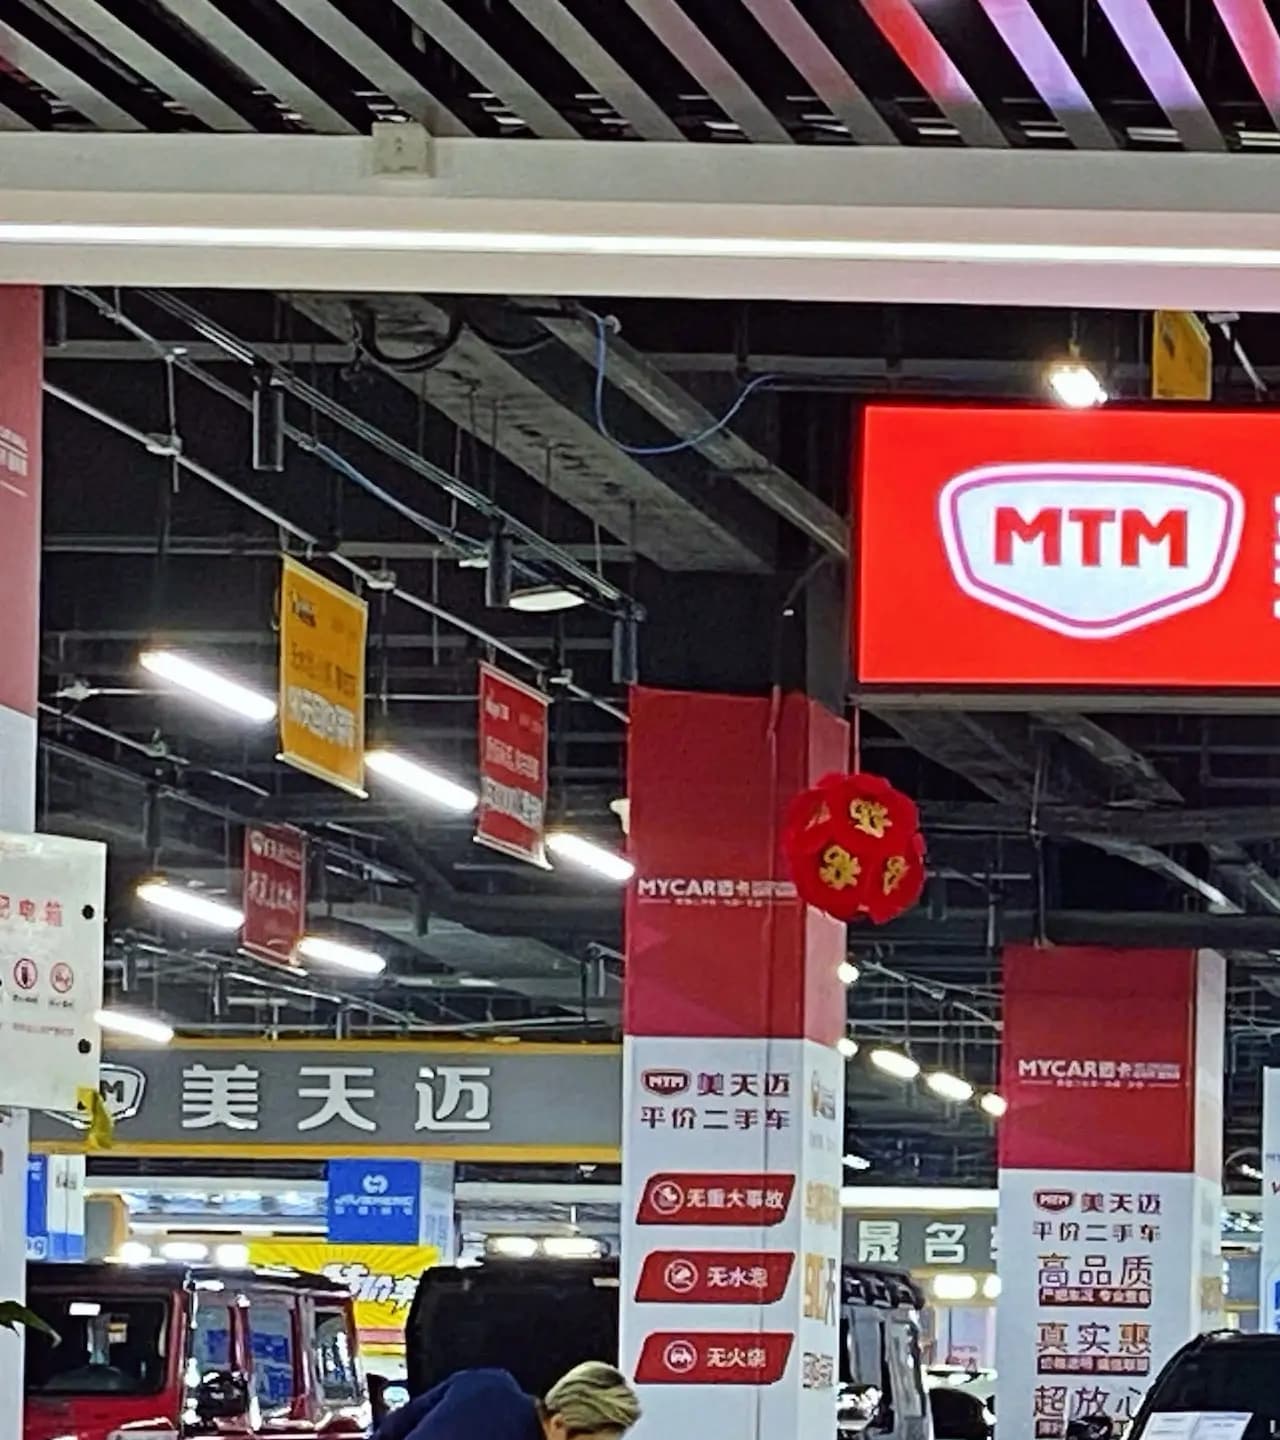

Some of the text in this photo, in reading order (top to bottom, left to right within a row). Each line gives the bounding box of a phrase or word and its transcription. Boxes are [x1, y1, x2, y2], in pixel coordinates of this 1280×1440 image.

[994, 506, 1188, 568] MTM
[182, 1063, 491, 1132] 美天迈
[697, 1072, 790, 1097] 美天迈
[640, 1106, 790, 1130] 平价二手车
[686, 1188, 785, 1210] 无重大事故
[1080, 1192, 1162, 1215] 美天迈
[857, 1216, 998, 1266] 晟名
[1032, 1221, 1161, 1243] 平价二手车
[1037, 1252, 1153, 1288] 高品质
[1036, 1321, 1153, 1354] 真实惠
